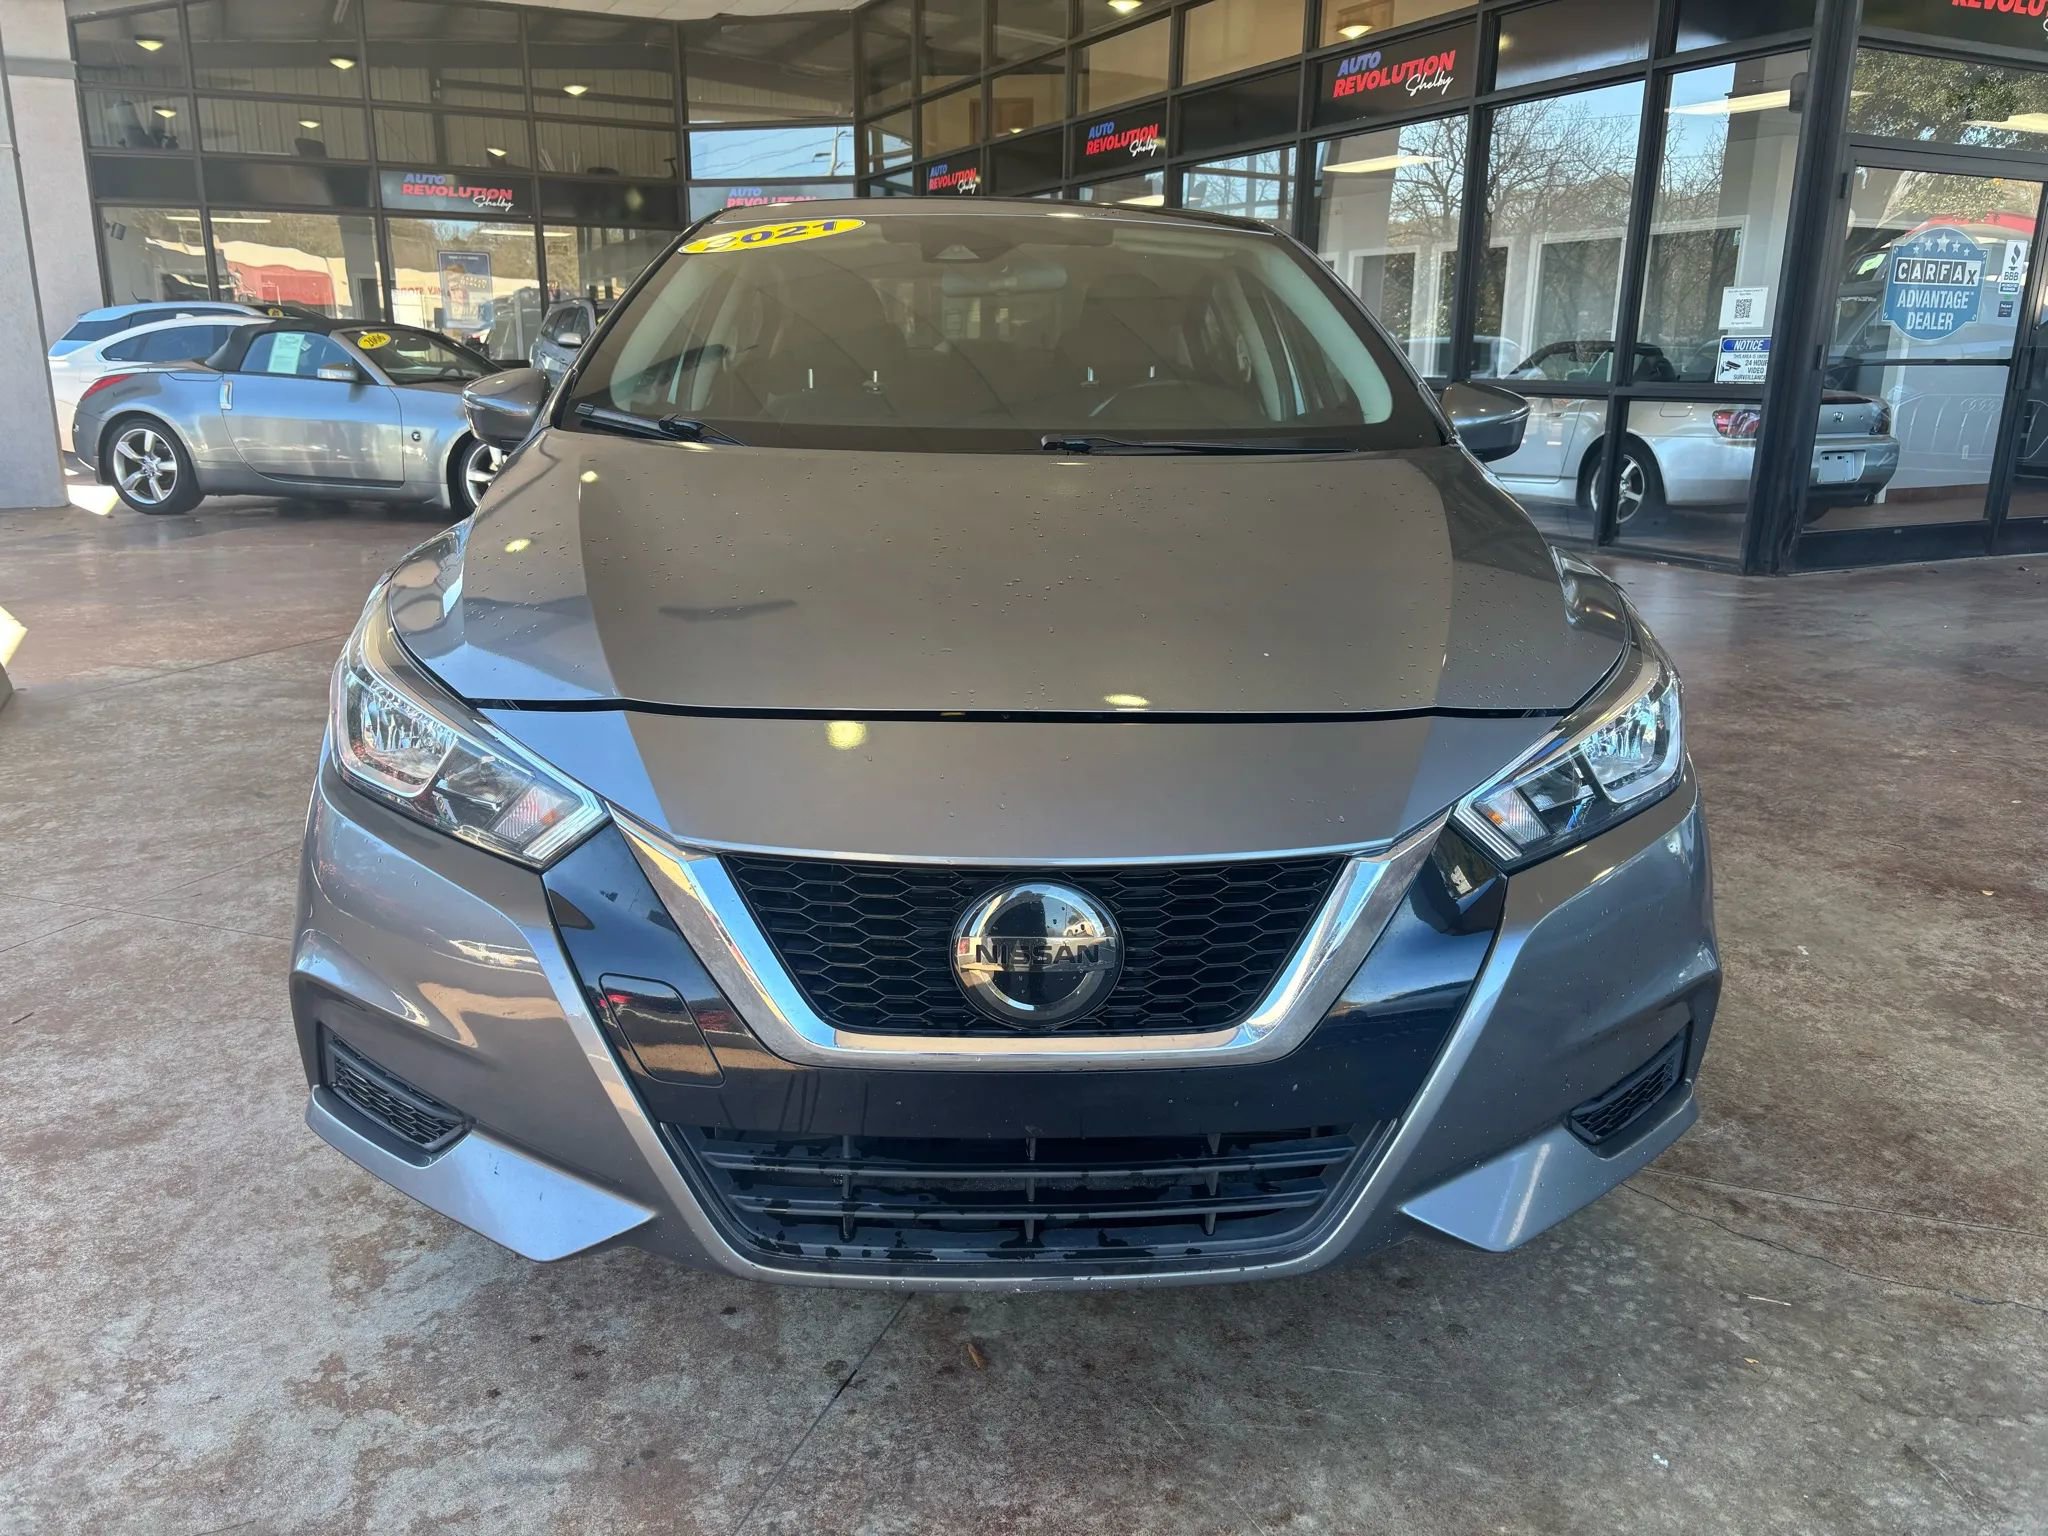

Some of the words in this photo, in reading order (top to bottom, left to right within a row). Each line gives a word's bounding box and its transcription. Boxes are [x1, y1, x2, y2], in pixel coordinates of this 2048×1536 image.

[1332, 50, 1456, 98] REVOLUTION
[1337, 51, 1382, 77] AUTO
[1405, 67, 1455, 97] Shelby
[1086, 123, 1159, 155] REVOLUTION
[1088, 121, 1115, 139] AUTO
[1129, 136, 1159, 157] Shelby
[403, 173, 446, 184] AUTO
[928, 168, 977, 191] REVOLUTION
[930, 164, 948, 178] AUTO
[402, 183, 513, 200] REVOLUTION
[729, 187, 762, 197] AUTO
[473, 195, 514, 212] Shelby
[703, 220, 837, 252] 2021
[1897, 262, 1978, 285] CARFAX
[2004, 272, 2019, 281] BBB
[1896, 289, 1970, 309] ADVANTAGE
[1906, 312, 1954, 330] DEALER
[1733, 340, 1763, 350] NOTICE
[975, 944, 1099, 964] NISSAN
